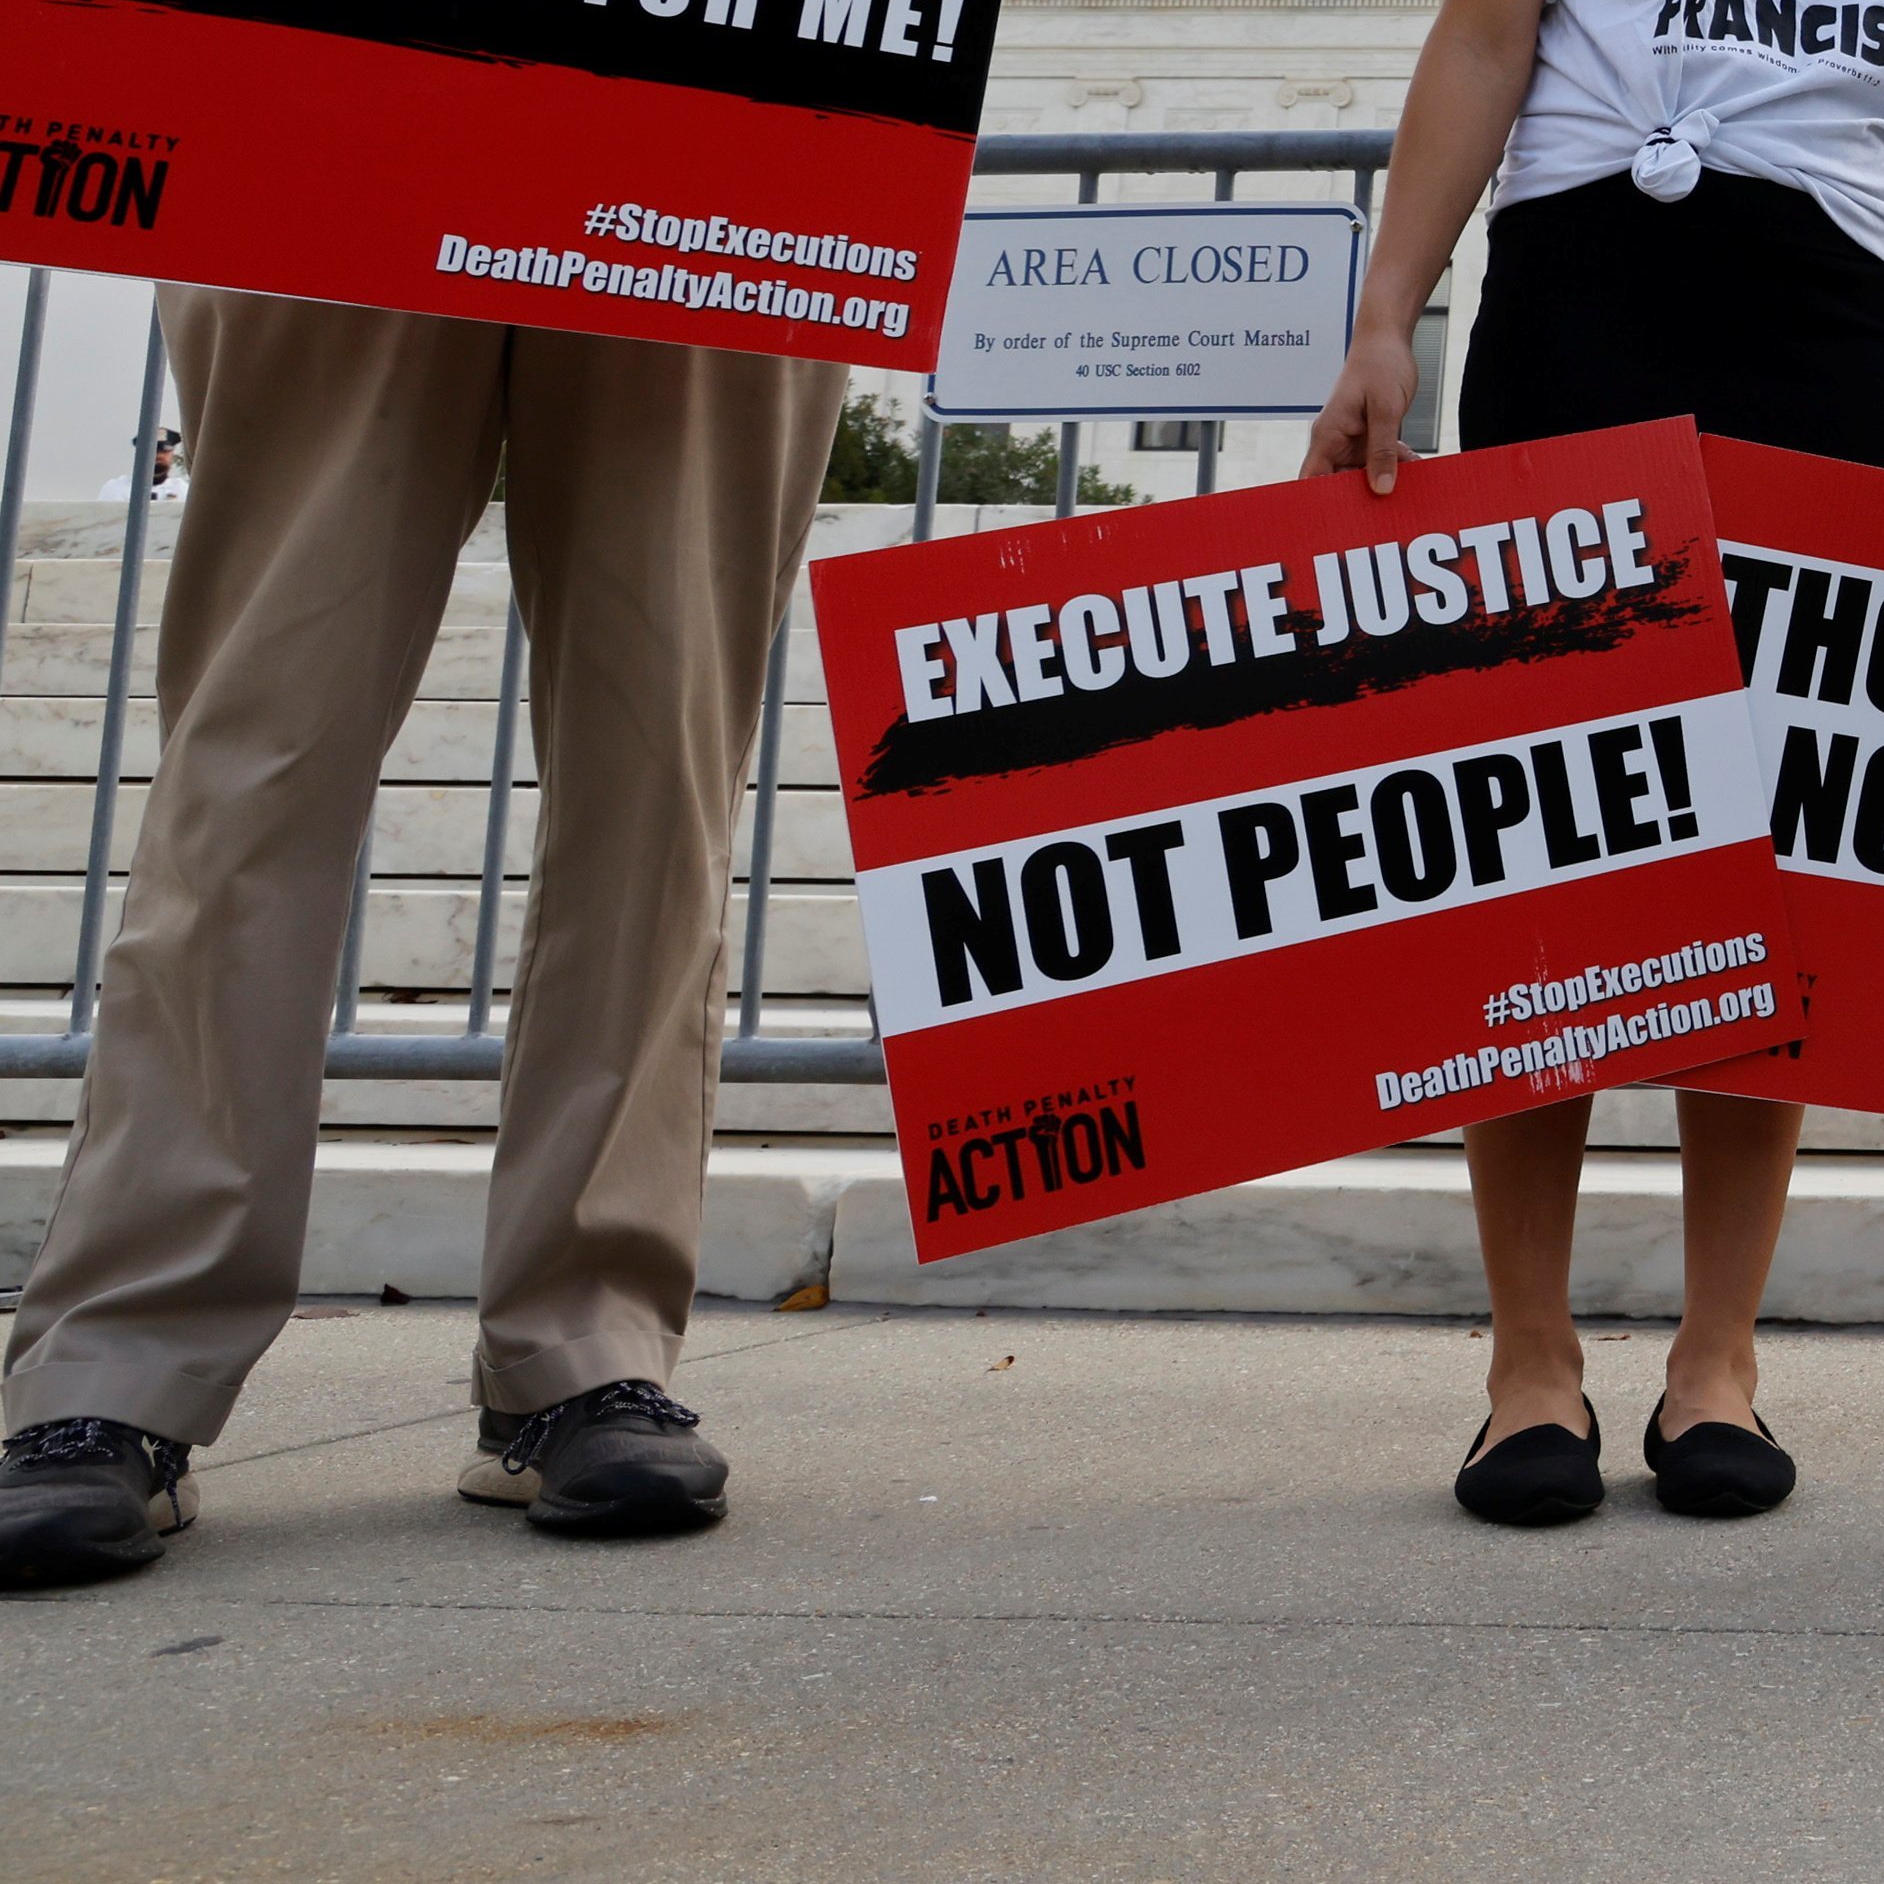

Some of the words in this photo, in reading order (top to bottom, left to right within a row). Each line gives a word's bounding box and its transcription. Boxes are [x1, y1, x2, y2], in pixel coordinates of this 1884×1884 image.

[1652, 44, 1678, 56] With
[1711, 44, 1753, 55] comes
[1818, 58, 1862, 80] Proverbs
[46, 121, 180, 152] PENALTY
[584, 201, 918, 281] #StopExecutions
[986, 248, 1111, 286] AREA
[1133, 245, 1309, 284] CLOSED
[436, 234, 909, 339] DeathPenaltyAction.org
[974, 333, 995, 353] By
[1003, 332, 1045, 350] order
[1054, 332, 1072, 349] of
[1080, 332, 1104, 349] the
[1111, 331, 1180, 351] Supreme
[1188, 330, 1234, 348] Court
[1244, 329, 1311, 347] Marshal
[1075, 365, 1089, 377] 40
[1095, 364, 1121, 377] USC
[1126, 363, 1170, 377] Section
[1175, 363, 1201, 376] 6102
[895, 562, 1299, 723] EXECUTE
[1313, 498, 1656, 646] JUSTICE
[923, 820, 1185, 1007] NOT
[1219, 716, 1699, 939] PEOPLE!
[1483, 932, 1767, 1028] #StopExecutions
[1375, 982, 1777, 1110] DeathPenaltyAction.org
[928, 1106, 1012, 1140] DEATH
[1024, 1077, 1136, 1114] PENALTY
[927, 1101, 1146, 1223] ACTION
